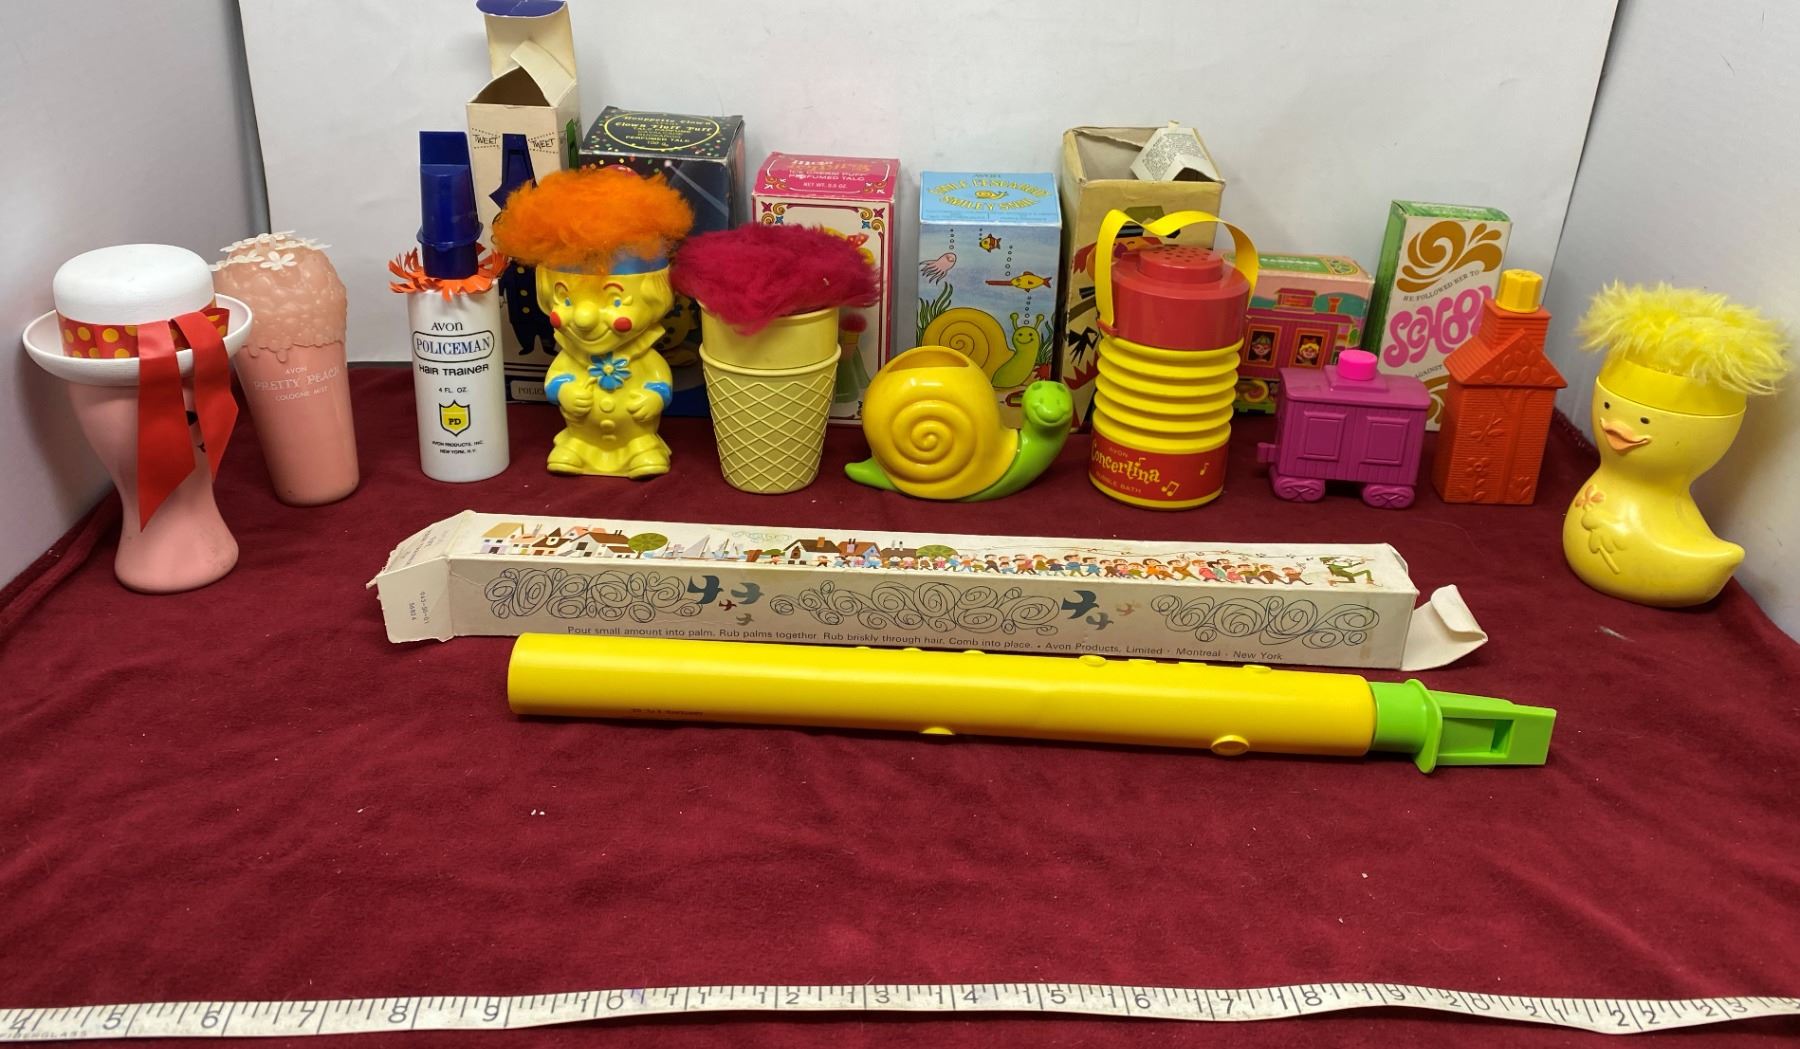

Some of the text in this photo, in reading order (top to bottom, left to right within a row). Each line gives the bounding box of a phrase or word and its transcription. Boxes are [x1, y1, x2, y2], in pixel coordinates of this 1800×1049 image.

[472, 133, 499, 145] TWEET
[530, 138, 557, 149] TWEET
[1416, 282, 1454, 301] FOLLOWED
[1454, 273, 1469, 286] HER
[1470, 269, 1480, 278] TO
[416, 336, 491, 356] POLICEMAN
[254, 366, 340, 391] PRETTY PEACH
[284, 367, 308, 375] AVON
[448, 418, 462, 426] PD
[1108, 446, 1129, 458] AVON
[1091, 439, 1161, 485] Concertina
[1119, 483, 1142, 494] BATH
[567, 626, 592, 635] Pour
[594, 627, 621, 636] small
[623, 628, 663, 637] amount
[665, 628, 686, 637] into
[688, 629, 717, 639] palm.
[719, 629, 741, 638] Rub
[743, 630, 773, 640] palms
[823, 631, 845, 641] Rub
[847, 632, 879, 643] briskly
[882, 634, 921, 645] through
[948, 636, 979, 647] Comb
[981, 638, 1001, 648] into
[1003, 639, 1033, 650] place.
[1045, 641, 1071, 650] Avon
[1126, 645, 1163, 655] Limited
[1175, 647, 1221, 658] Montreal
[1232, 649, 1257, 660] New
[1258, 651, 1283, 661] York
[9, 1014, 33, 1033] 4
[103, 1012, 124, 1030] 5
[201, 1010, 220, 1028] 6
[299, 1009, 316, 1028] 7
[388, 1004, 409, 1024] 8
[482, 1004, 500, 1022] 9
